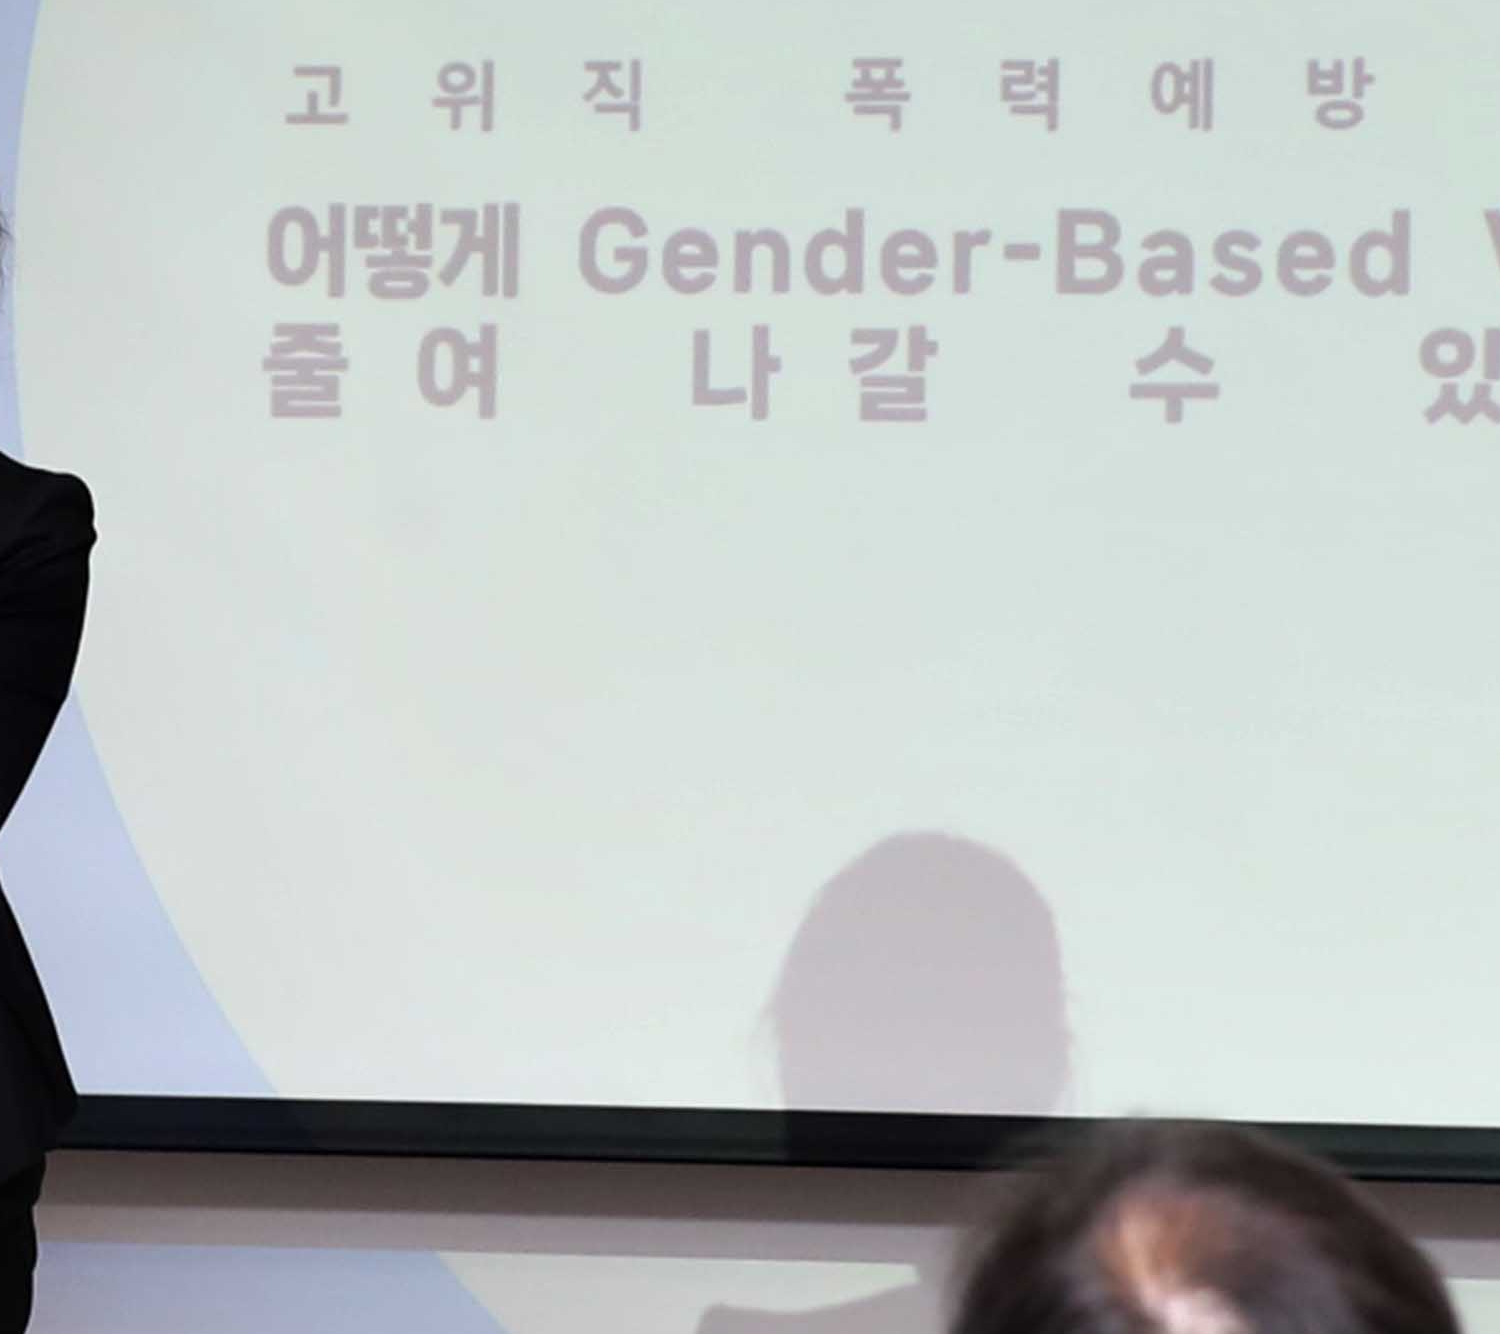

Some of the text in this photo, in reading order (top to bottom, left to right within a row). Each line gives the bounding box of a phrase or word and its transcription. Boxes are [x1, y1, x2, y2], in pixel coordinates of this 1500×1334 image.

[286, 60, 642, 131] 고위직
[845, 57, 1375, 131] 폭력예방
[267, 203, 520, 300] 어떻게
[578, 207, 1411, 297] Gender-Based
[263, 323, 498, 418] 줄여
[693, 326, 939, 421] 나갈
[1130, 326, 1219, 423] 수
